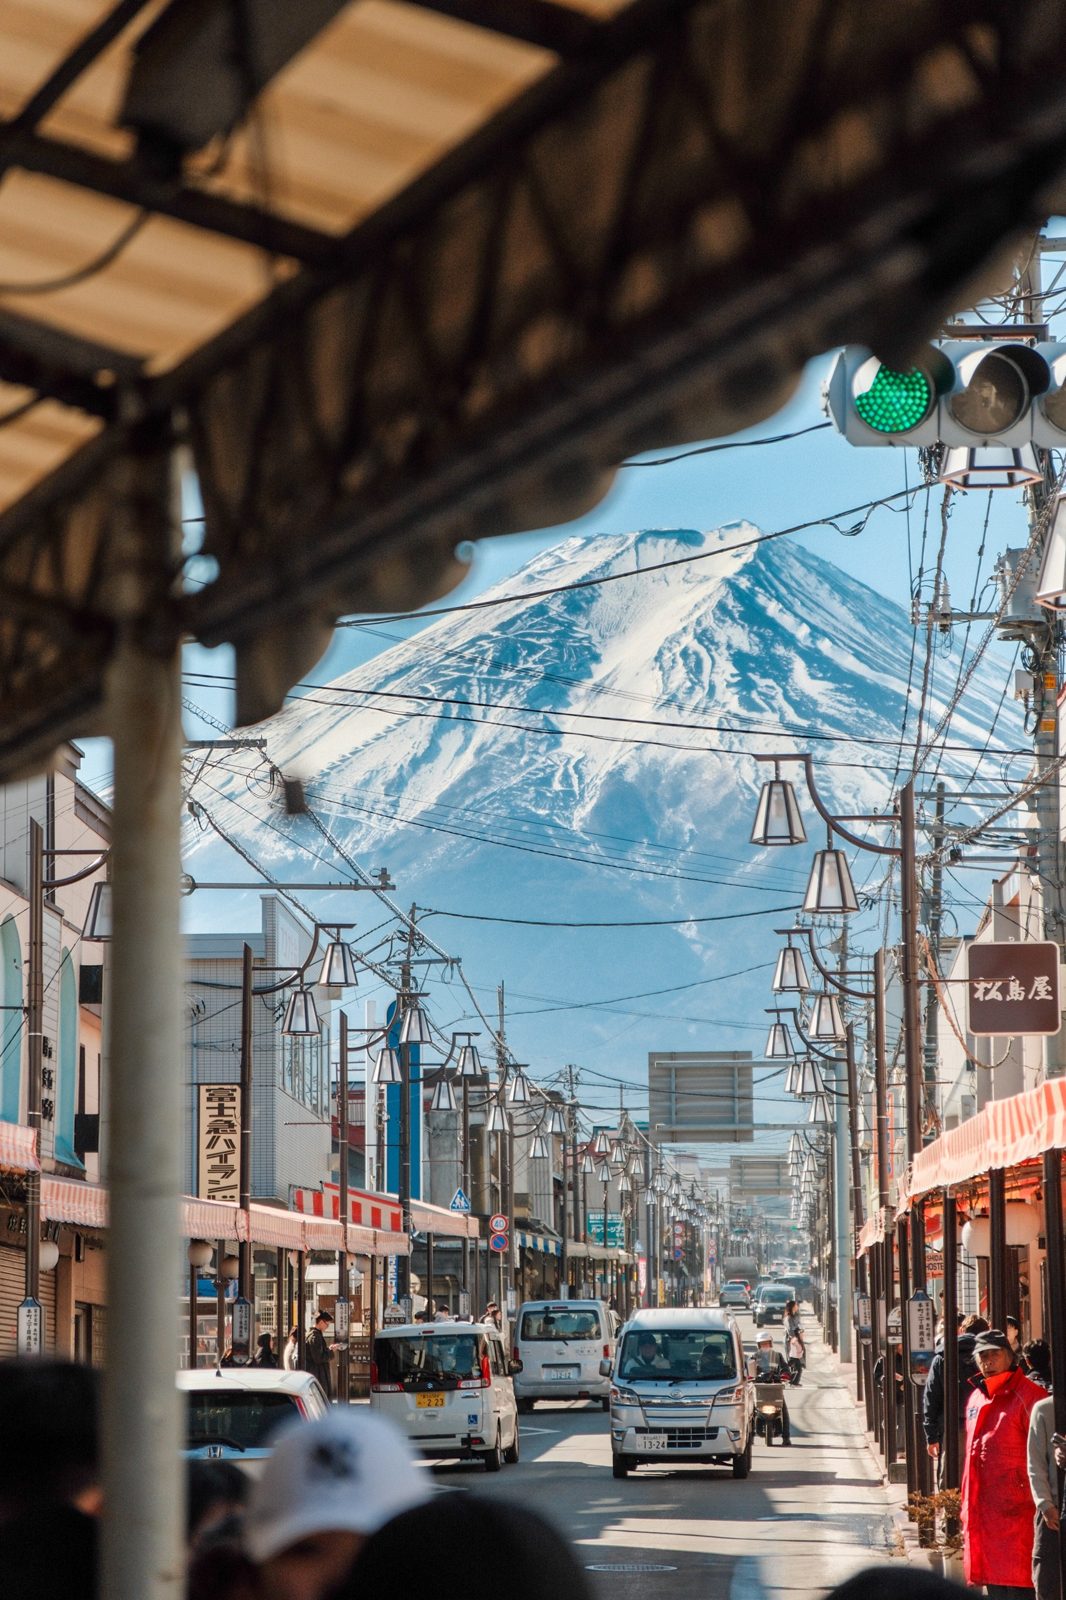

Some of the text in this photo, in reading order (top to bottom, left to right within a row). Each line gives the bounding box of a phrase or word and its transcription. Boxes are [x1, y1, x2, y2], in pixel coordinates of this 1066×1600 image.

[973, 975, 1054, 1002] 松島屋
[643, 1440, 666, 1449] 13-24
